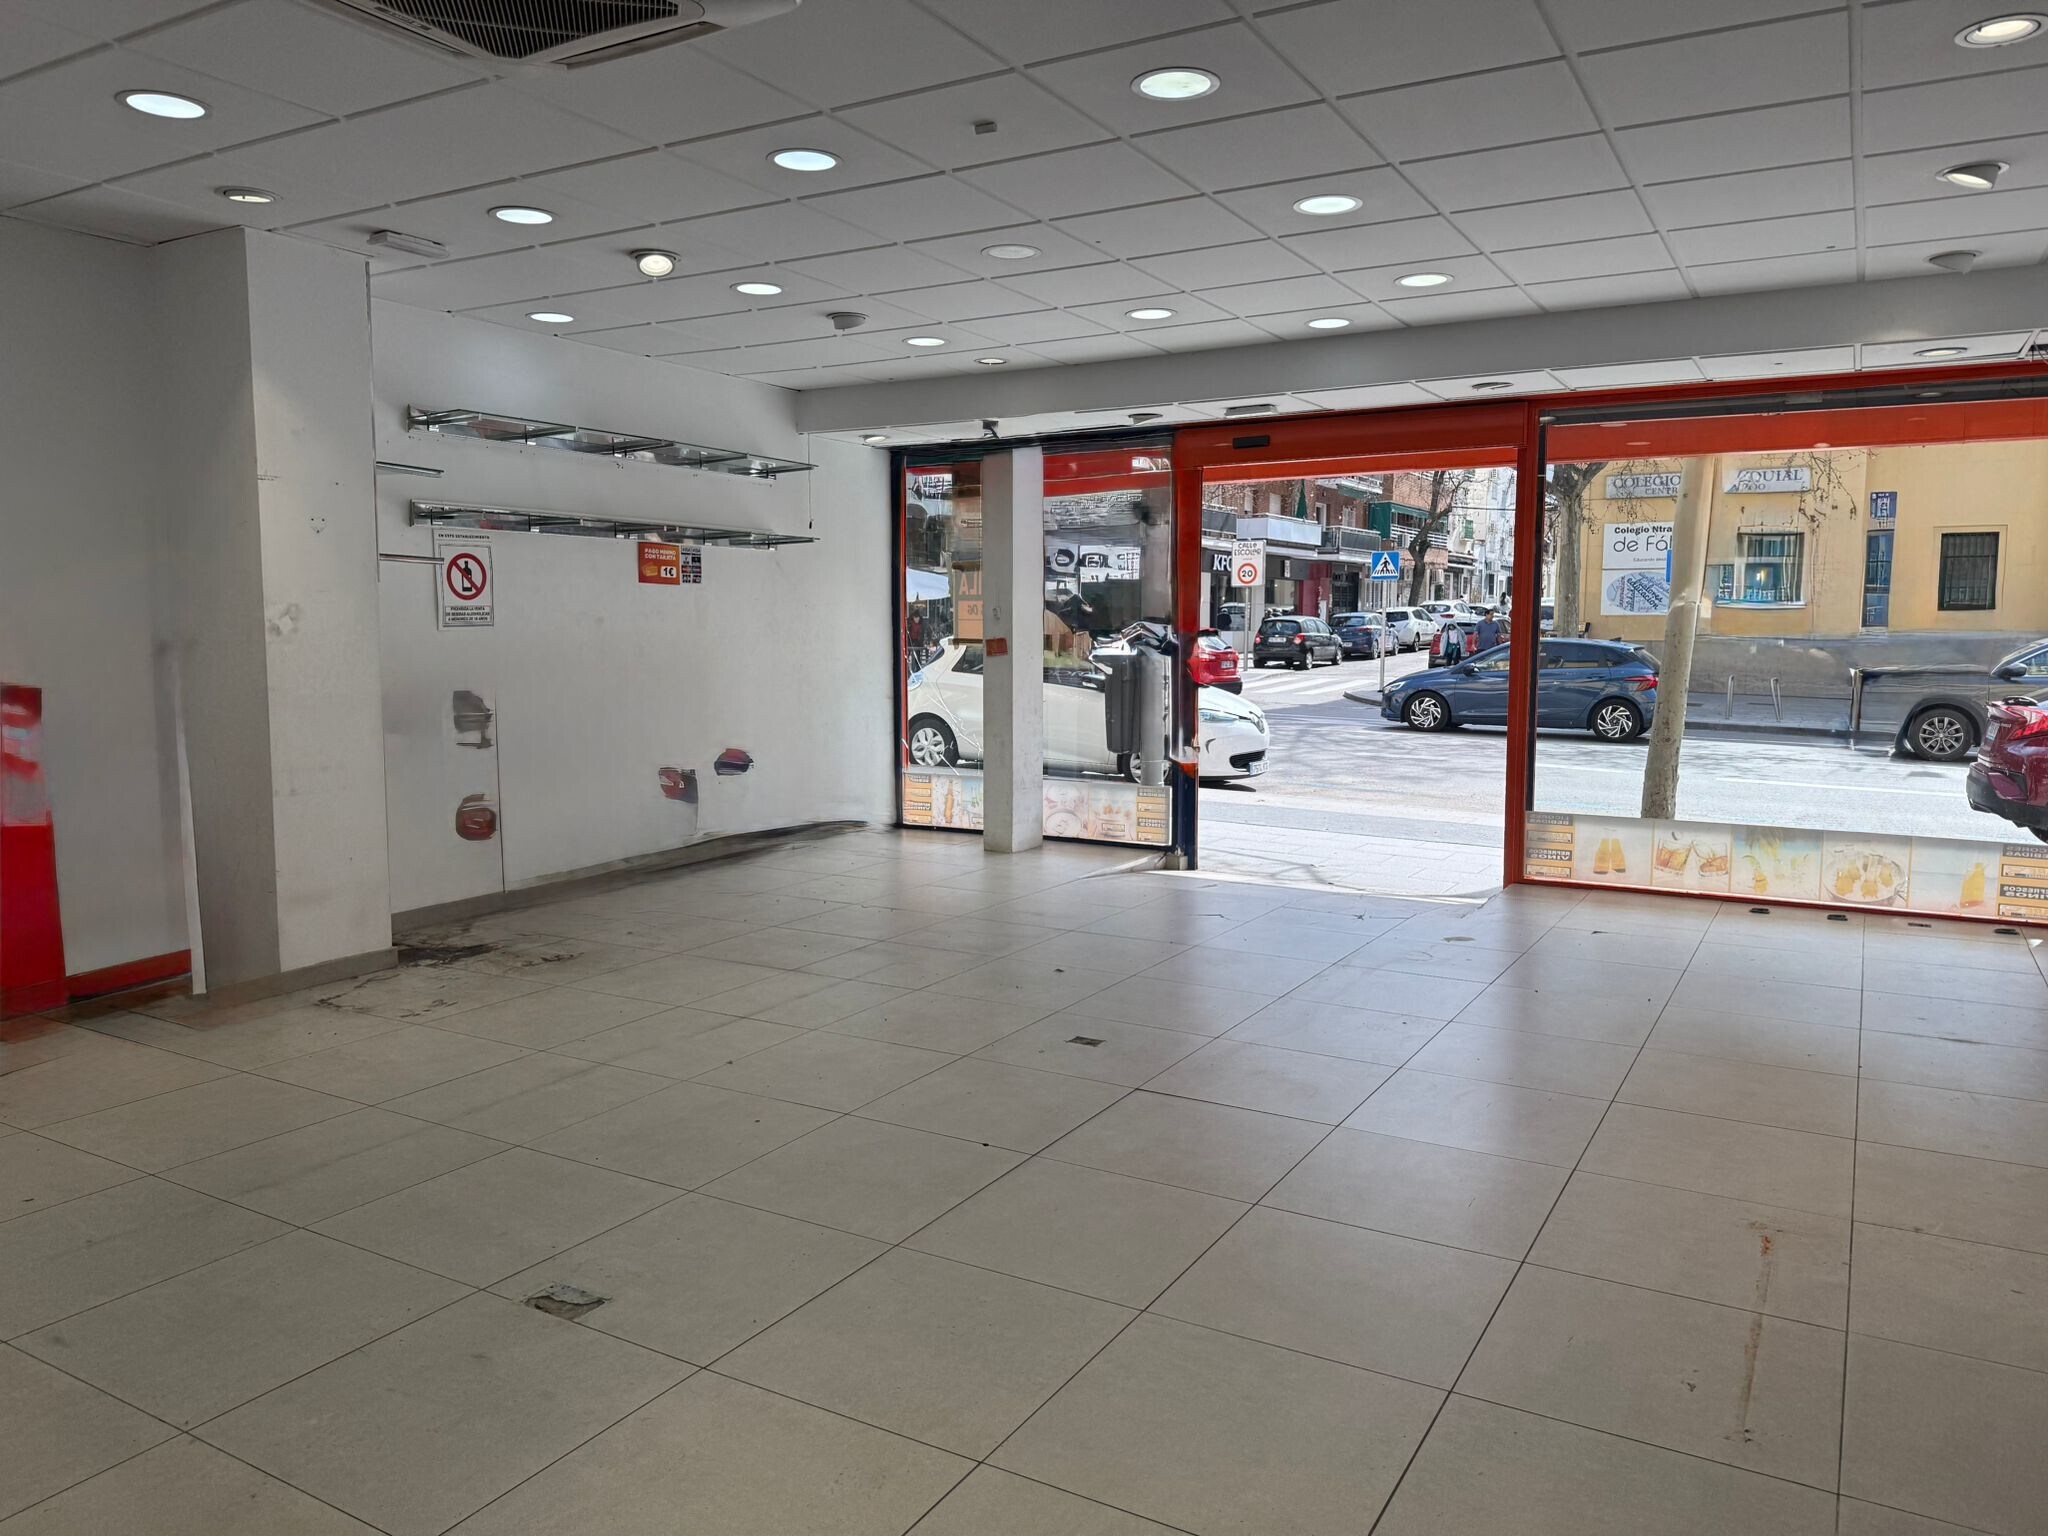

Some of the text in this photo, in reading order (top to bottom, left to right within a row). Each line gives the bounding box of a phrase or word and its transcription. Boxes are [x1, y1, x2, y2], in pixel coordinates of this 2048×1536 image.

[1613, 475, 1681, 489] COLEGIO
[1614, 526, 1650, 536] Colegio
[1613, 536, 1639, 553] de
[663, 567, 675, 577] 1€
[1241, 569, 1253, 578] 20
